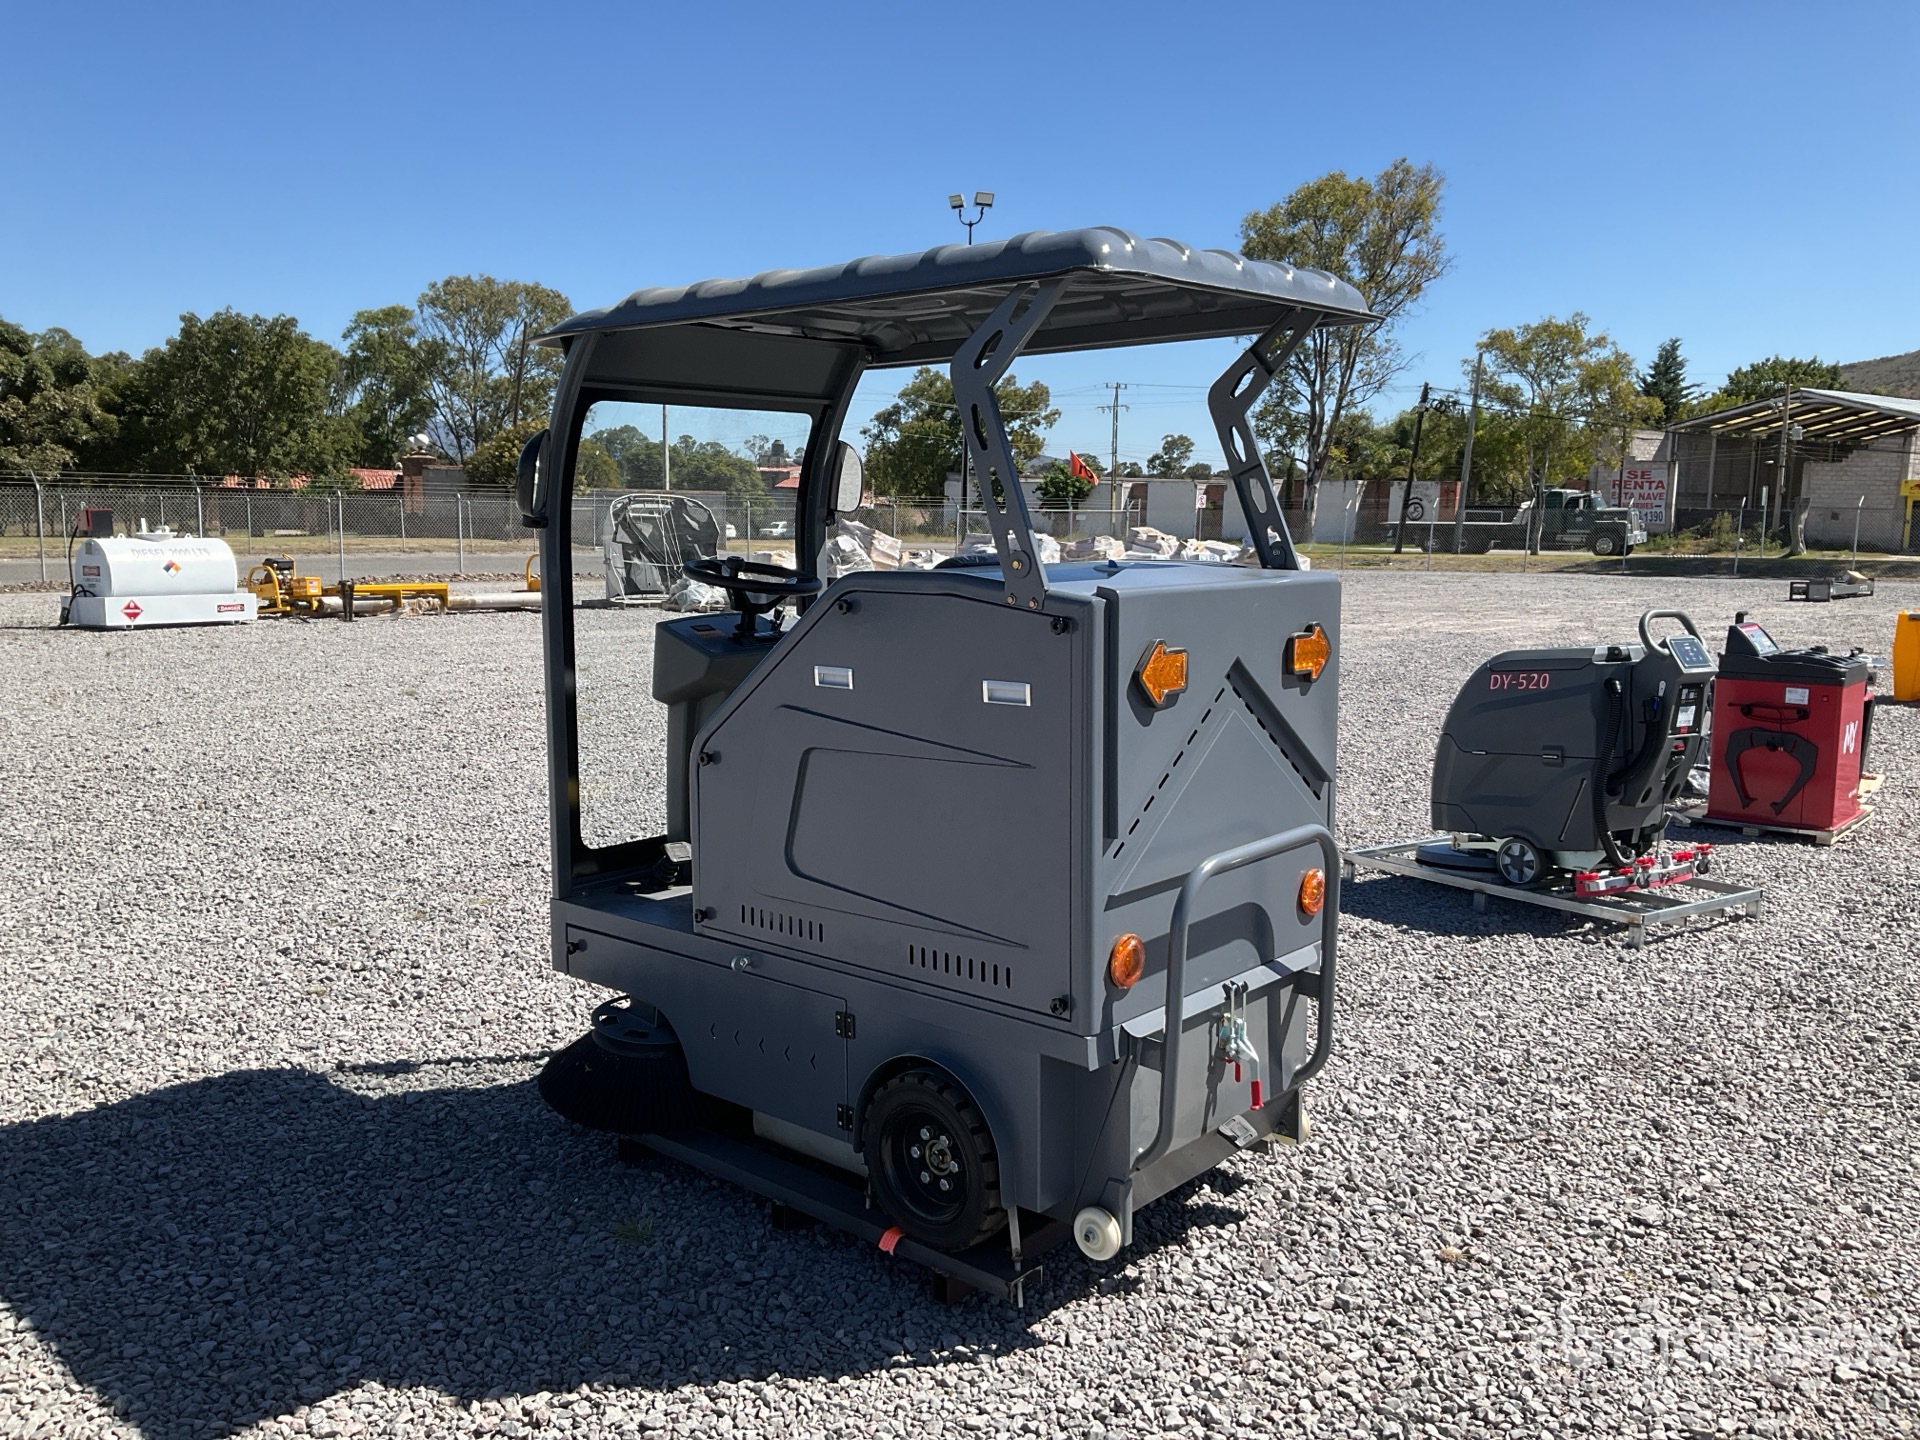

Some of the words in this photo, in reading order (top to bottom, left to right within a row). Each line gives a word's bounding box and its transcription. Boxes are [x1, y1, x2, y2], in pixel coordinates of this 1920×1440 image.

[1626, 470, 1653, 480] SE
[1612, 480, 1665, 490] RENTA
[1611, 491, 1635, 500] ETA
[1638, 492, 1665, 501] NAVE
[1490, 673, 1550, 690] DY-520
